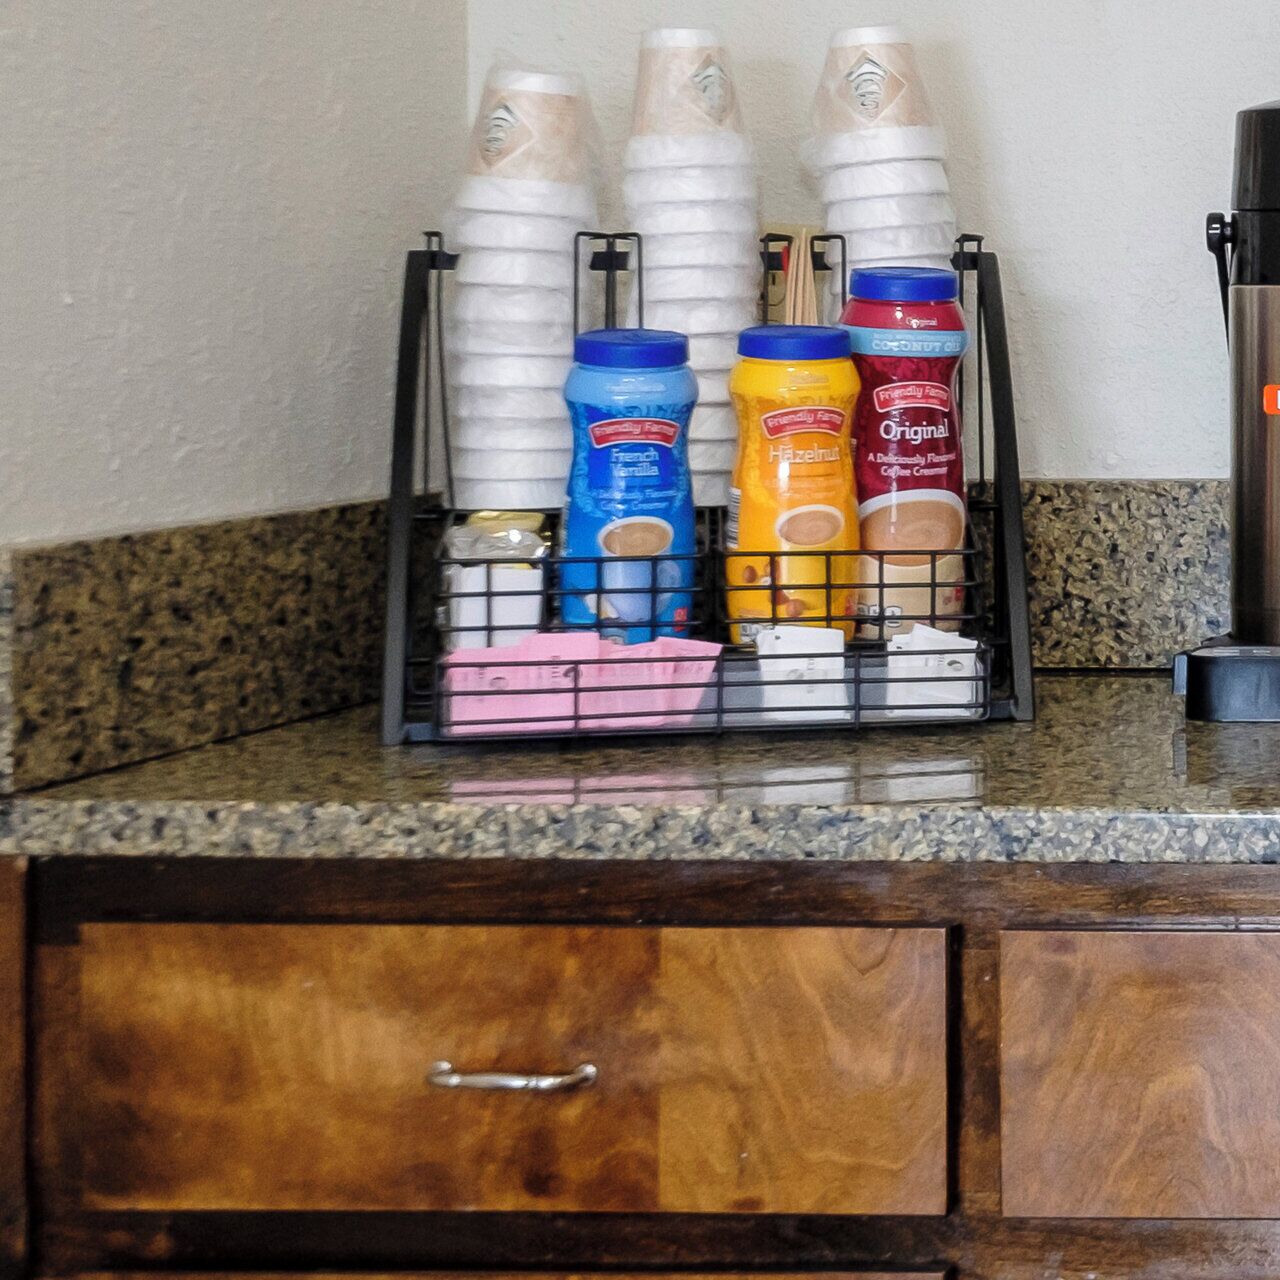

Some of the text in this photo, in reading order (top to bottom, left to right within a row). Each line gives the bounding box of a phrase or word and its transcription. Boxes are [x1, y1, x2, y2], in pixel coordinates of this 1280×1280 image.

[879, 386, 923, 402] Friendly
[767, 412, 814, 428] Friendly
[879, 419, 949, 445] Original
[611, 447, 659, 462] French
[769, 443, 840, 464] Hazelnut
[868, 453, 875, 462] A
[610, 462, 660, 476] Vanilla
